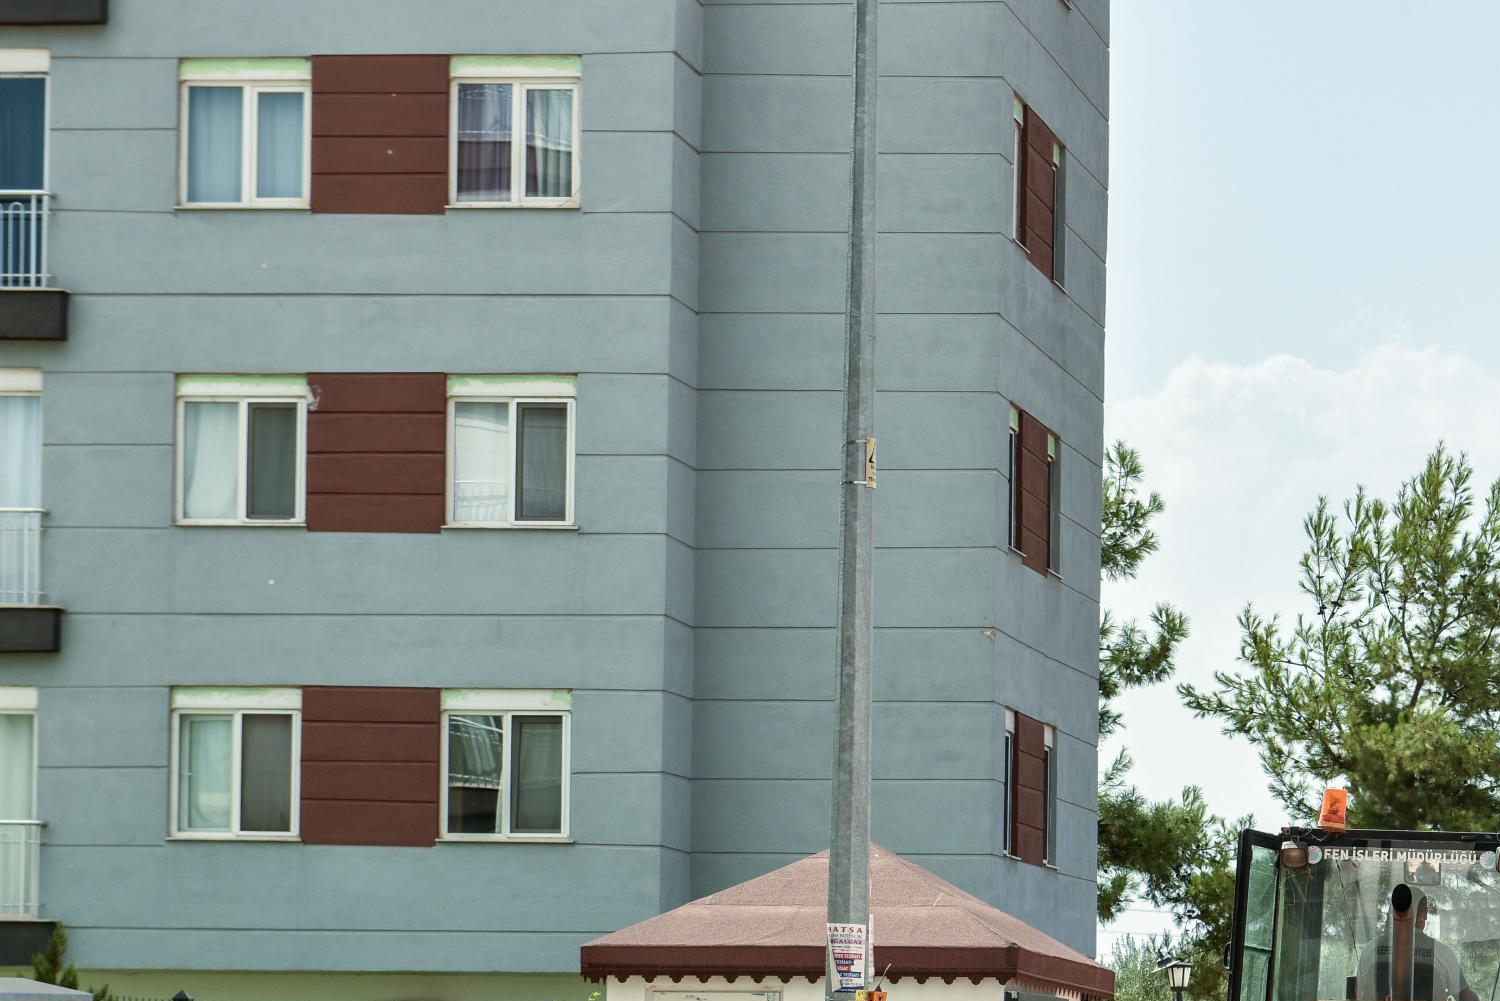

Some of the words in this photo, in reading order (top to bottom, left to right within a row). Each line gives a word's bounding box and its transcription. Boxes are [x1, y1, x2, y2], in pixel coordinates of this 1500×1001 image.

[1324, 848, 1349, 860] FEN
[1352, 846, 1393, 862] İŞLERİ
[1396, 849, 1477, 865] MÜDÜRLÜĞÜ
